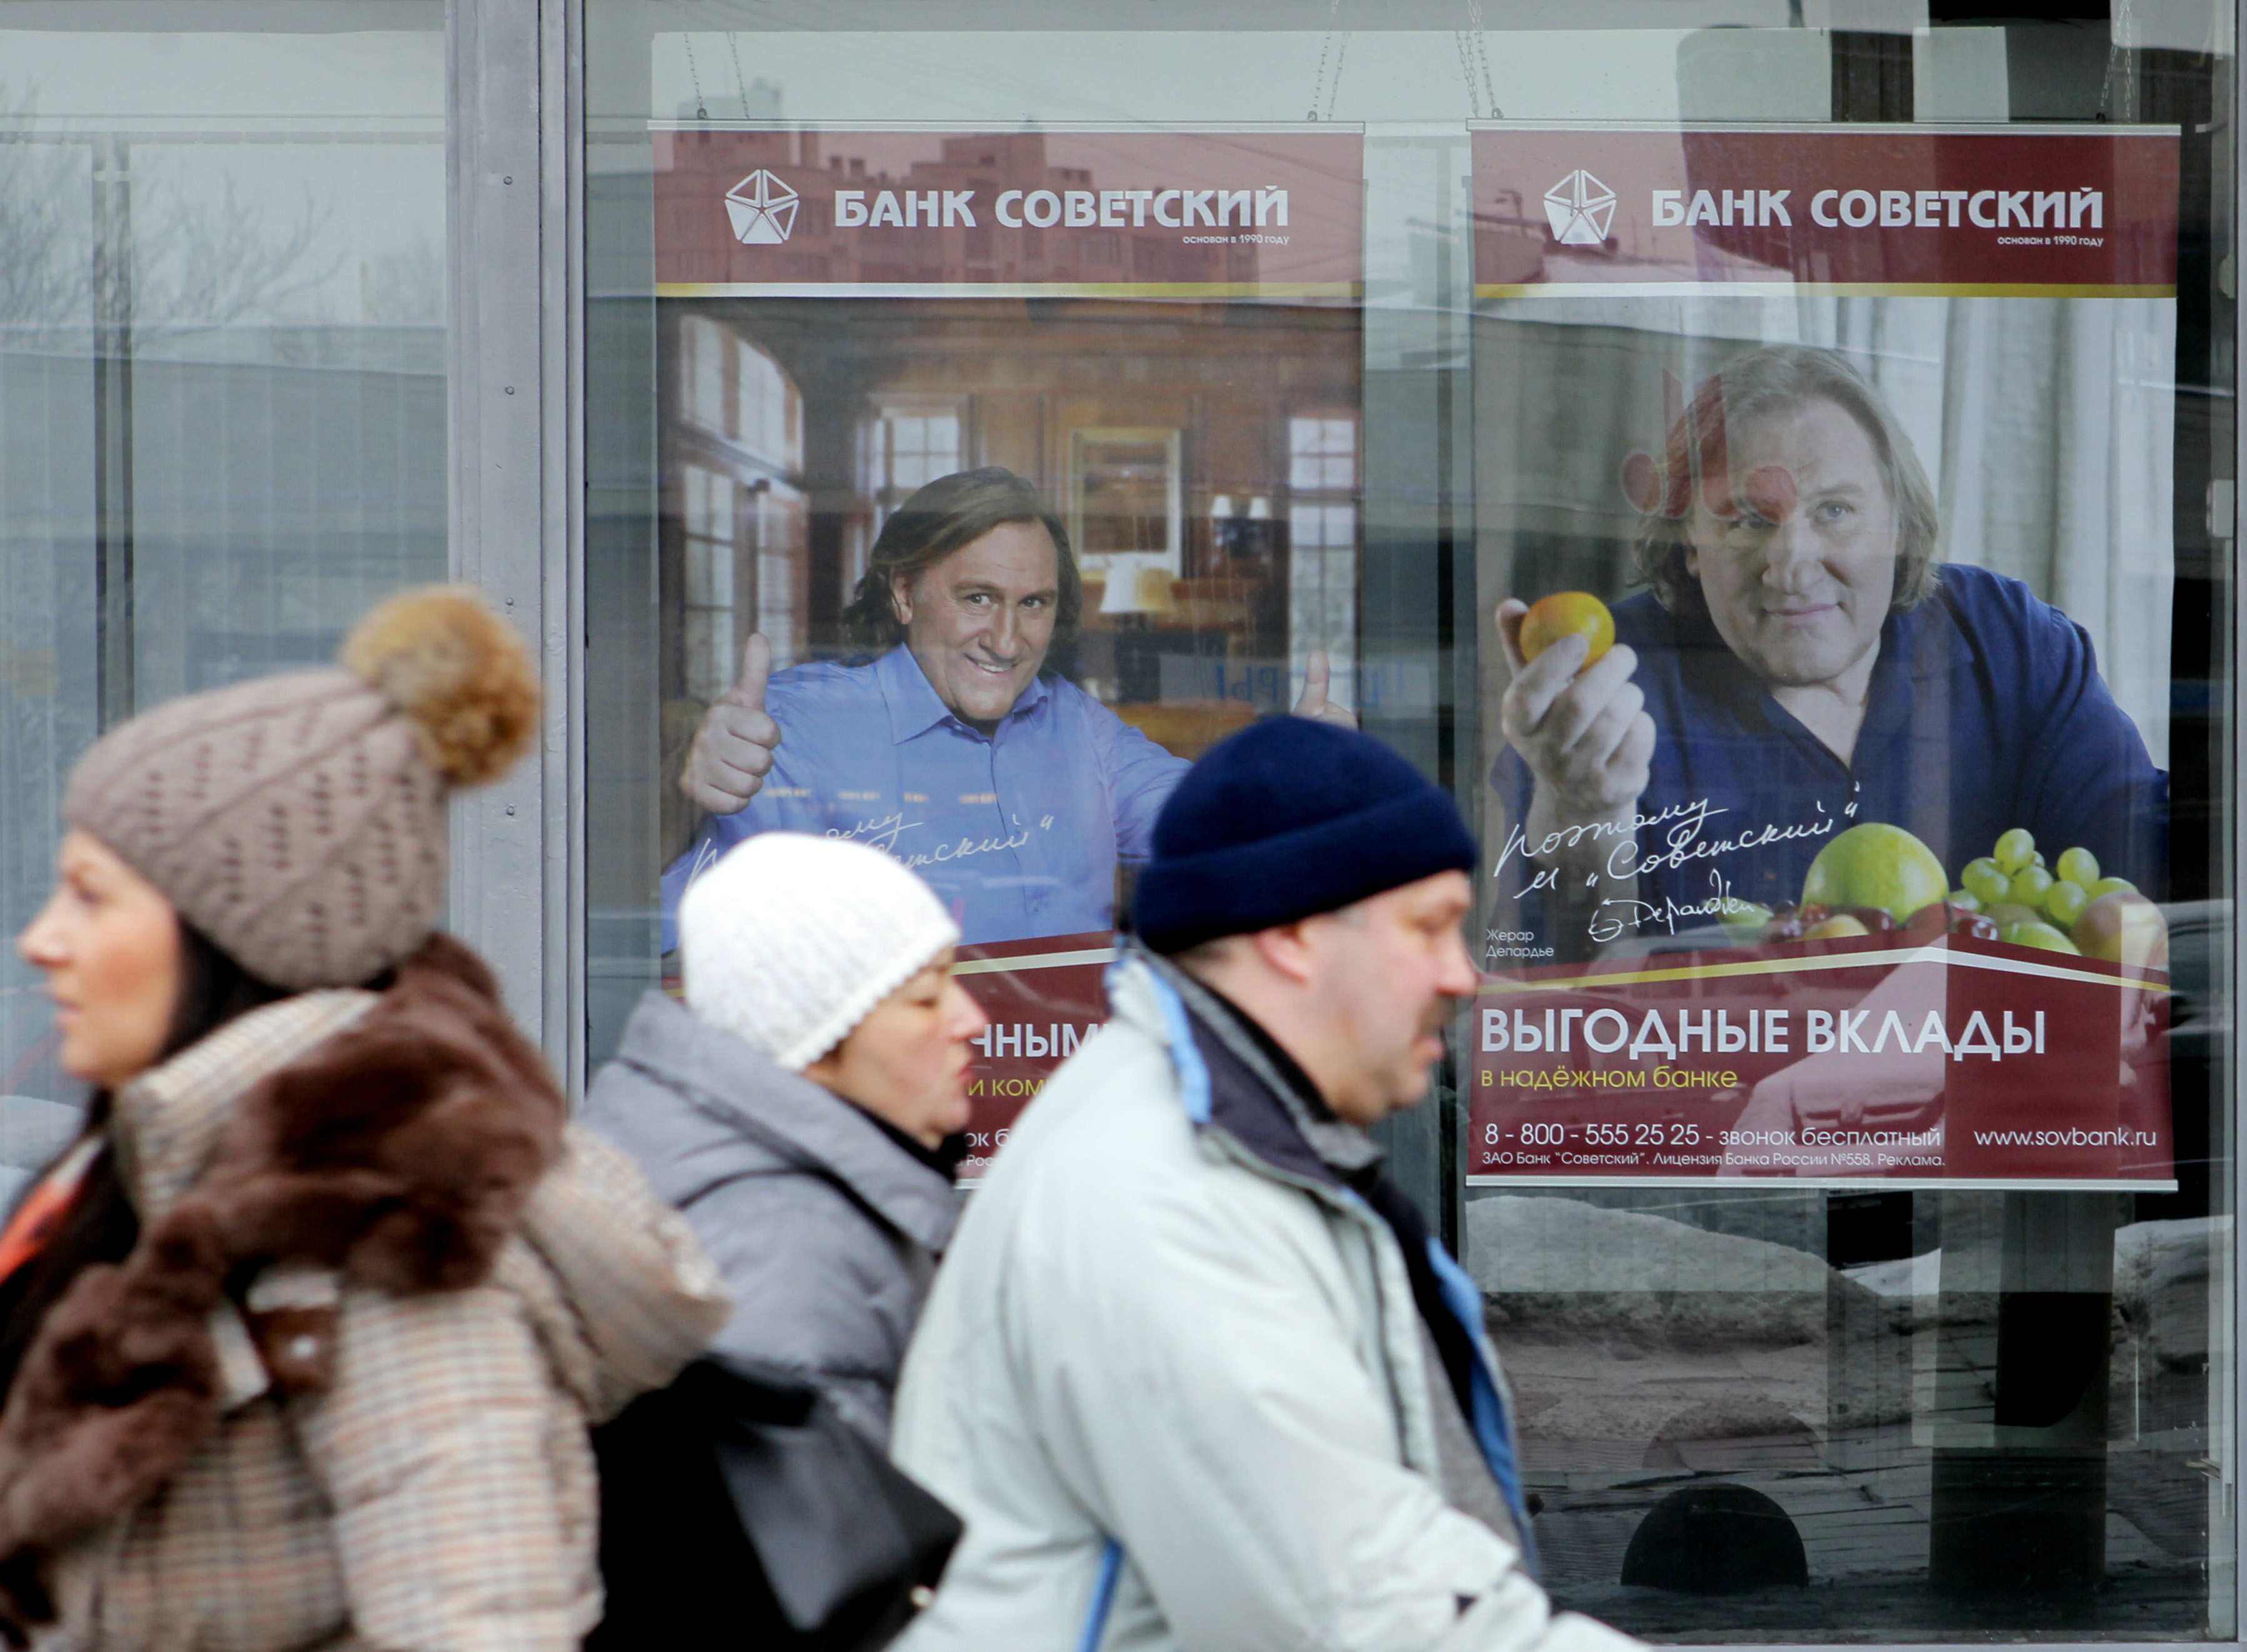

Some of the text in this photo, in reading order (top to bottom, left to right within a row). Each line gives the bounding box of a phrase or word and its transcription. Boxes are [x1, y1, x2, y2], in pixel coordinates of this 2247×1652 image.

[834, 185, 1289, 228] БАНК СОВЕТСКИЙ
[1651, 186, 2104, 228] БАНК СОВЕТСКИЙ
[1183, 234, 1290, 246] основан в 1990 году
[1997, 235, 2104, 248] основан в 1990 году
[1486, 929, 1534, 943] Жерар
[1486, 945, 1554, 958] Депардье
[1481, 1008, 2046, 1062] ВЫГОДНЫЕ ВКЛАДЫ
[1481, 1065, 1738, 1091] в надёжном банке
[1484, 1123, 1499, 1145] 8
[1520, 1123, 1564, 1145] 800
[1584, 1123, 1629, 1146] 555
[1634, 1123, 1665, 1146] 25
[1670, 1123, 1700, 1146] 25
[1718, 1130, 1796, 1146] звонок
[1801, 1127, 1941, 1147] бесплатный
[1973, 1126, 2156, 1146] www.sovbank.ru
[1482, 1151, 1514, 1165] ЗАО
[1516, 1151, 1551, 1165] Банк
[1653, 1152, 1723, 1167] Лицензия
[1725, 1153, 1770, 1166] Банка
[1773, 1153, 1828, 1166] России
[1830, 1153, 1874, 1166] №558.
[1878, 1153, 1946, 1167] Реклама.
